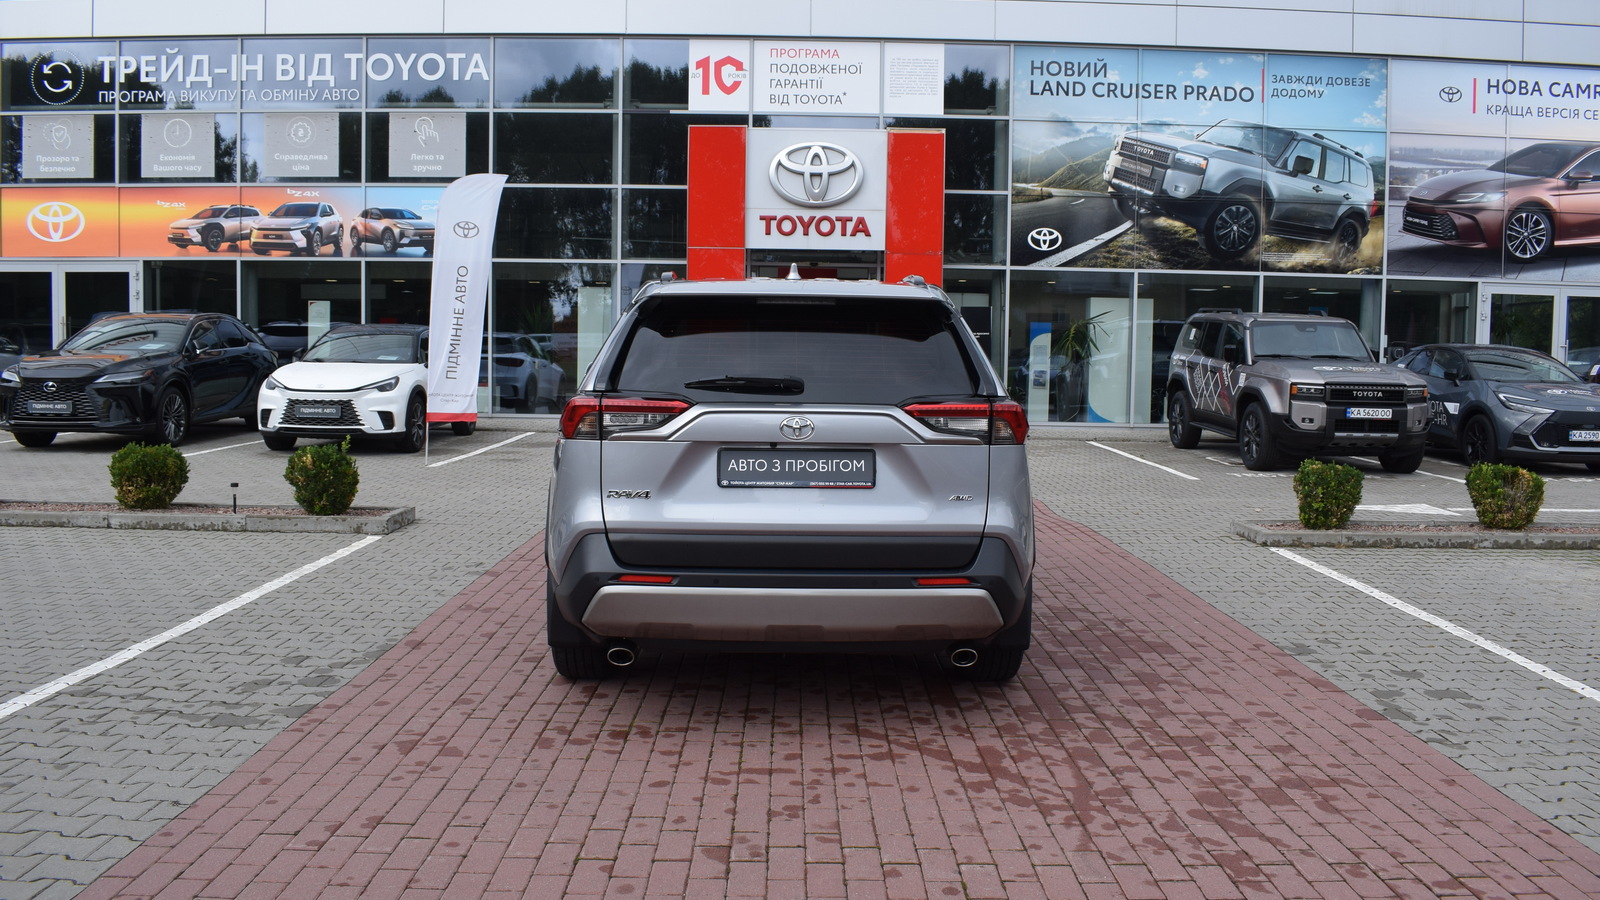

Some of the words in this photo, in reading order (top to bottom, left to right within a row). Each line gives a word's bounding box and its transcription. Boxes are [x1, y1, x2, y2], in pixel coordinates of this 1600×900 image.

[769, 48, 840, 59] ПРОГРАМА
[98, 47, 263, 88] ТРЕЙД-ІН
[276, 53, 335, 87] ВІД
[344, 53, 490, 82] TOYOTA
[769, 62, 863, 75] ПОДОВЖЕНОЇ
[1030, 58, 1108, 78] НОВИЙ
[769, 77, 824, 89] ГАРАНТІЇ
[1271, 74, 1323, 86] ЗАВЖДИ
[1325, 76, 1371, 88] ДОВЕЗЕ
[1029, 80, 1086, 97] LAND
[1091, 82, 1178, 100] CRUISER
[1183, 84, 1255, 103] PRADO
[1270, 88, 1325, 99] ДОДОМУ
[1487, 78, 1544, 97] НОВА
[98, 89, 177, 103] ПРОГРАМА
[180, 89, 238, 103] ВИКУПУ
[240, 89, 258, 101] ТА
[260, 88, 319, 101] ОБМІНУ
[322, 88, 360, 101] АВТО
[769, 93, 790, 105] ВІД
[1486, 104, 1534, 118] КРАЩА
[1537, 106, 1580, 119] ВЕРСІЯ
[1134, 145, 1154, 156] TOYOTA
[36, 154, 71, 164] Прозоро
[274, 153, 328, 162] Справедлива
[40, 165, 76, 173] безпечно
[153, 164, 183, 172] Вашого
[412, 165, 442, 173] зручно
[759, 215, 872, 237] TOYOTA
[454, 265, 469, 304] АВТО
[445, 307, 465, 380] ПІДМІННЕ
[1350, 408, 1361, 417] KA
[1363, 408, 1379, 417] 5620
[1572, 431, 1583, 440] KA
[1583, 431, 1600, 440] 2590
[727, 459, 768, 472] АВТО
[771, 459, 781, 472] З
[785, 459, 865, 472] ПРОБІГОМ
[606, 489, 652, 500] RAV4
[948, 494, 974, 502] AWD
